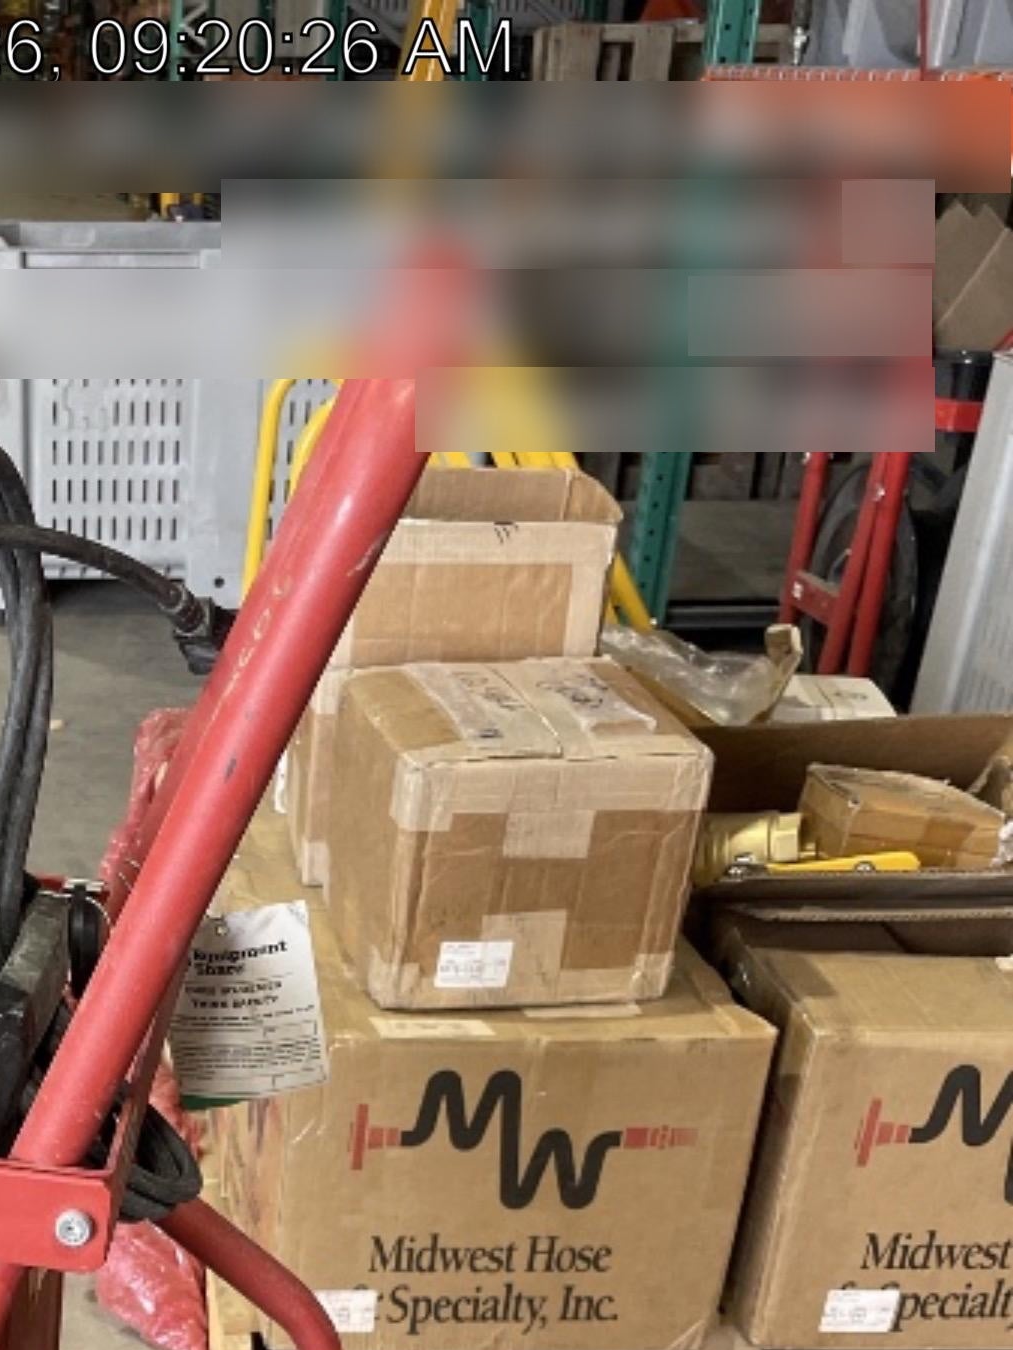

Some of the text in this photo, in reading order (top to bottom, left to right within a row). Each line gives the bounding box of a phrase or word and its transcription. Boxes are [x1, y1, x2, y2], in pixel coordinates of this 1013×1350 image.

[368, 1233, 613, 1272] Midwest Hose
[861, 1230, 1013, 1269] Midwest
[387, 1283, 548, 1335] Specialty,
[557, 1285, 618, 1321] Inc.
[881, 1278, 1013, 1332] pecialt
